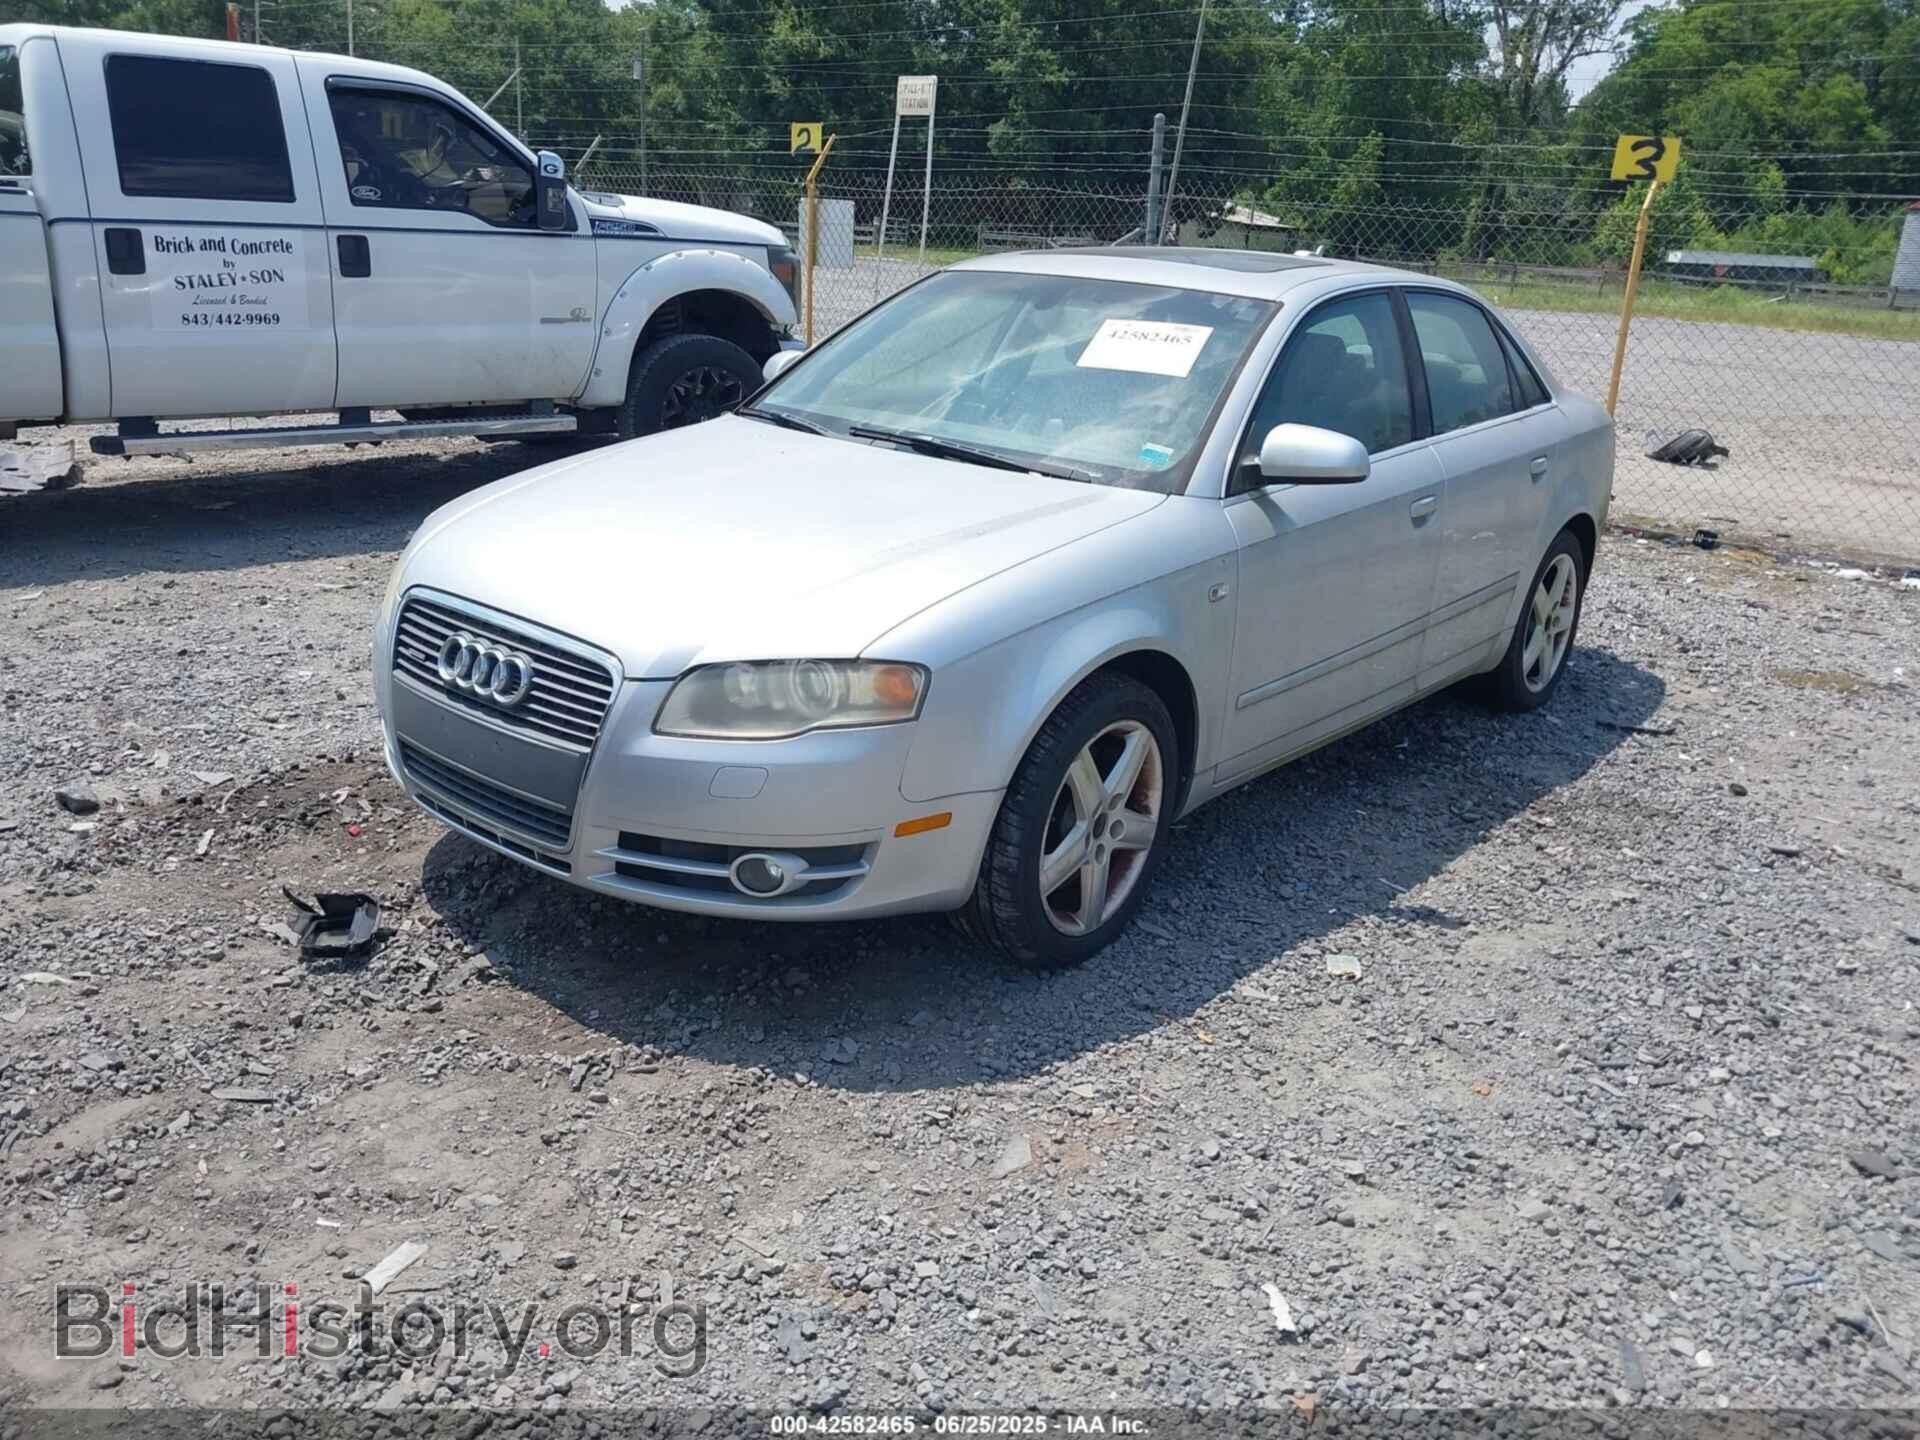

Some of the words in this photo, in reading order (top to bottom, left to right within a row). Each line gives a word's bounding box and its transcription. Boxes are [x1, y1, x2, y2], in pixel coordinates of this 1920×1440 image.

[792, 127, 816, 154] 2
[1626, 137, 1665, 181] 3
[154, 235, 195, 254] Brick
[200, 237, 226, 252] and
[231, 238, 294, 255] Concrete
[223, 258, 236, 271] by
[174, 272, 238, 290] STALEY
[250, 269, 285, 284] SON
[181, 313, 280, 327] 843/442-9969
